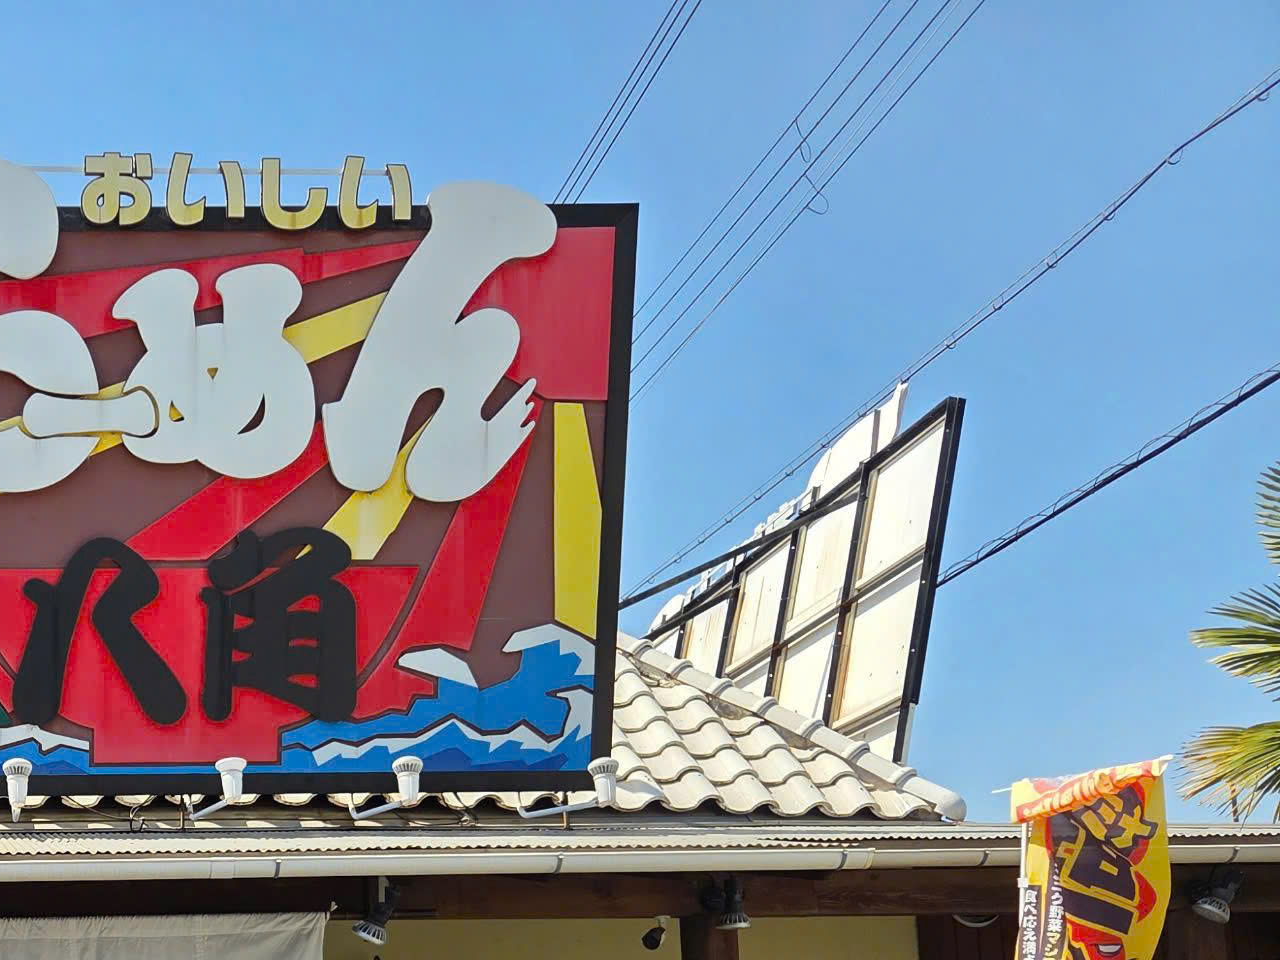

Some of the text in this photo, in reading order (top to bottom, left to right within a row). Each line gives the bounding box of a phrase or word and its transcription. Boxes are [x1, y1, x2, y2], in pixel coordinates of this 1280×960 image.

[81, 151, 412, 230] おいしい
[11, 527, 358, 726] 八角
